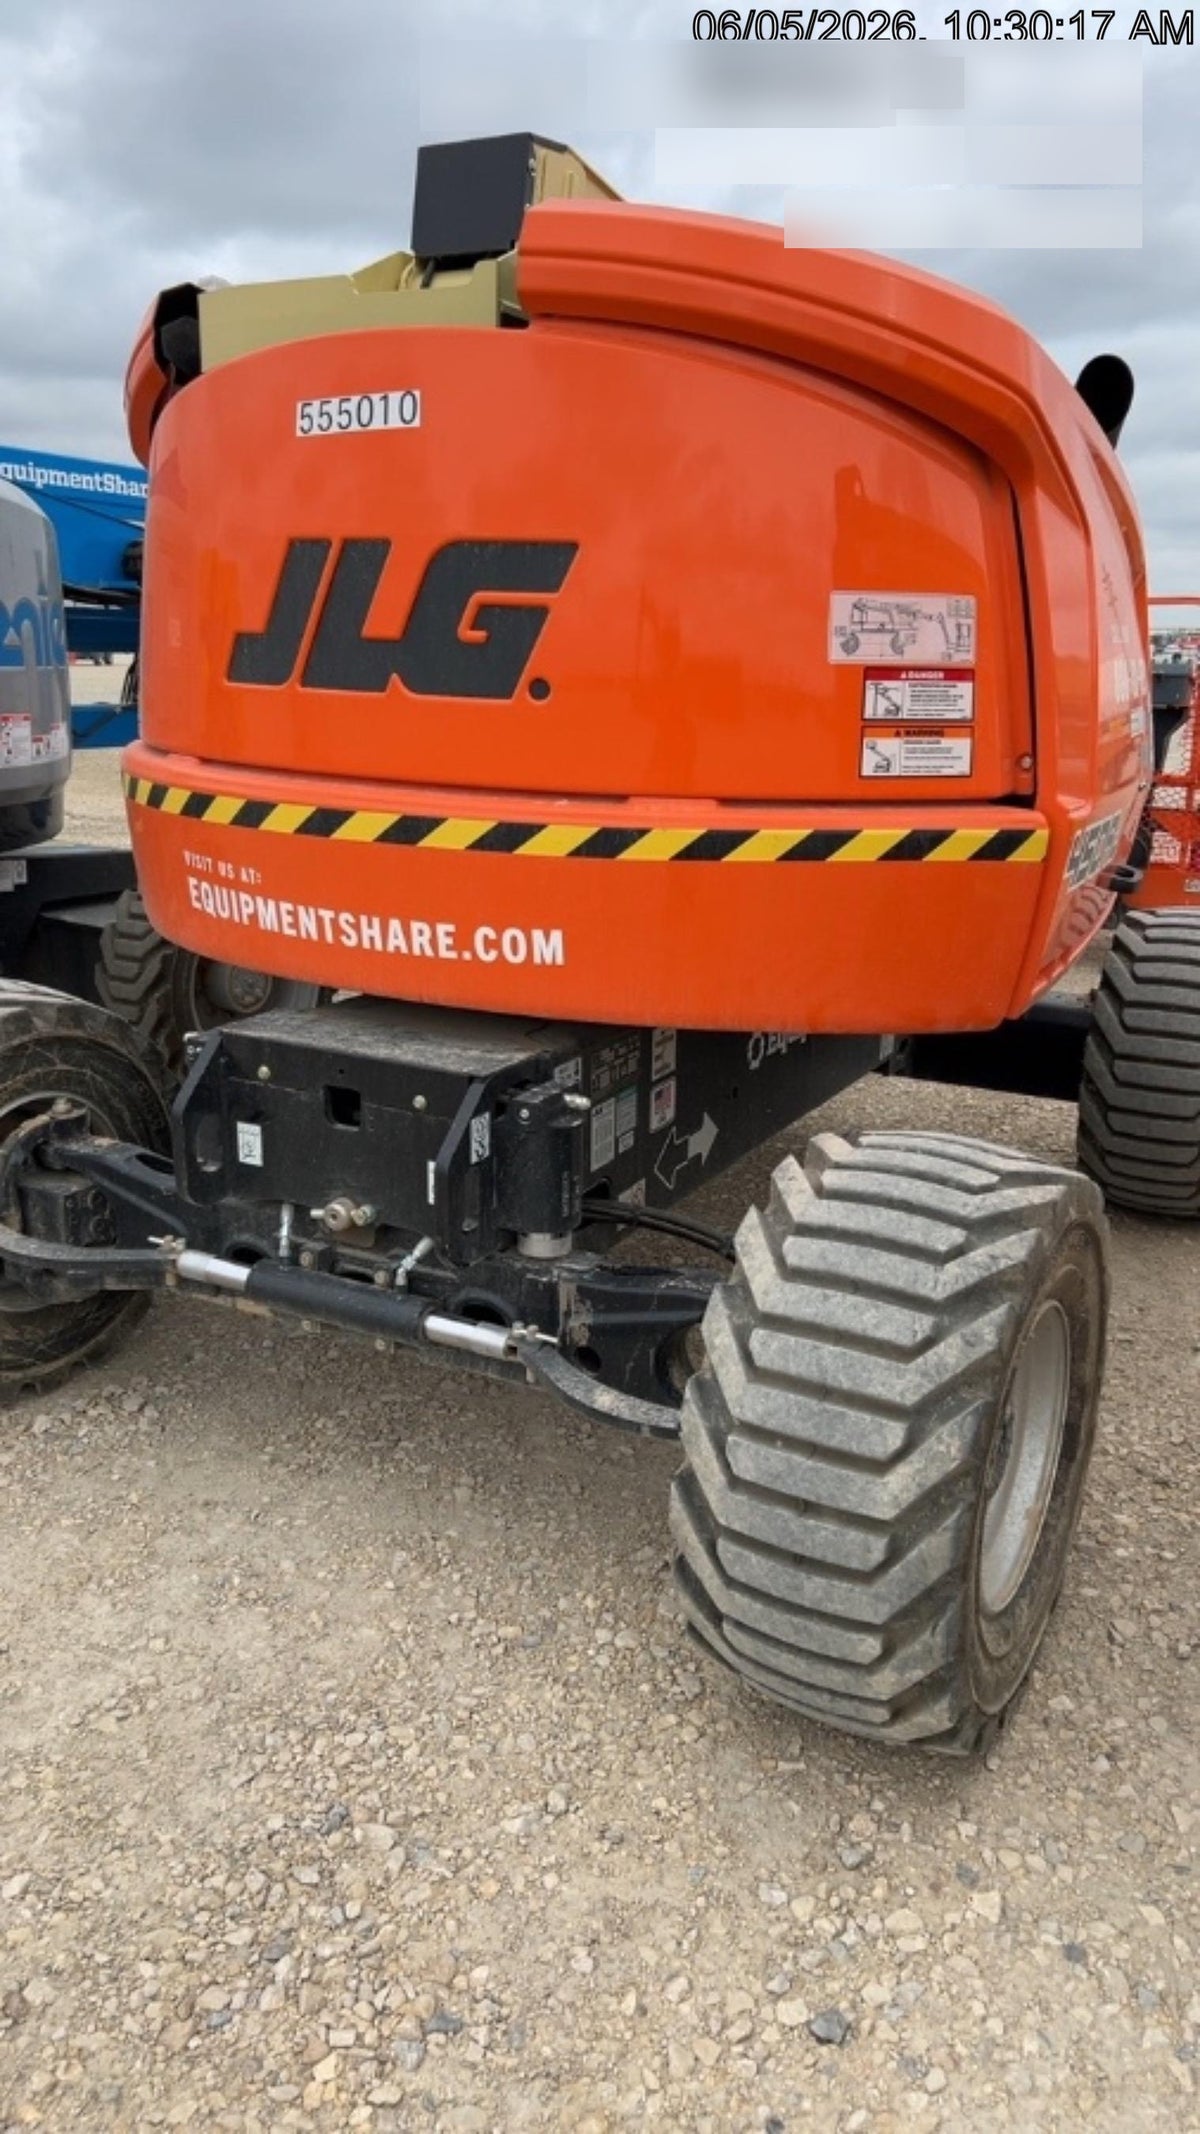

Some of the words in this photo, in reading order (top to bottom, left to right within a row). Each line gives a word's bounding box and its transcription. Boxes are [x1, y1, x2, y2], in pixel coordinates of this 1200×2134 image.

[300, 391, 418, 434] 555010
[184, 850, 213, 873] VISIT
[217, 860, 235, 880] US
[240, 866, 262, 885] AT:
[187, 875, 565, 967] EQUIPMENTSHARE.COM
